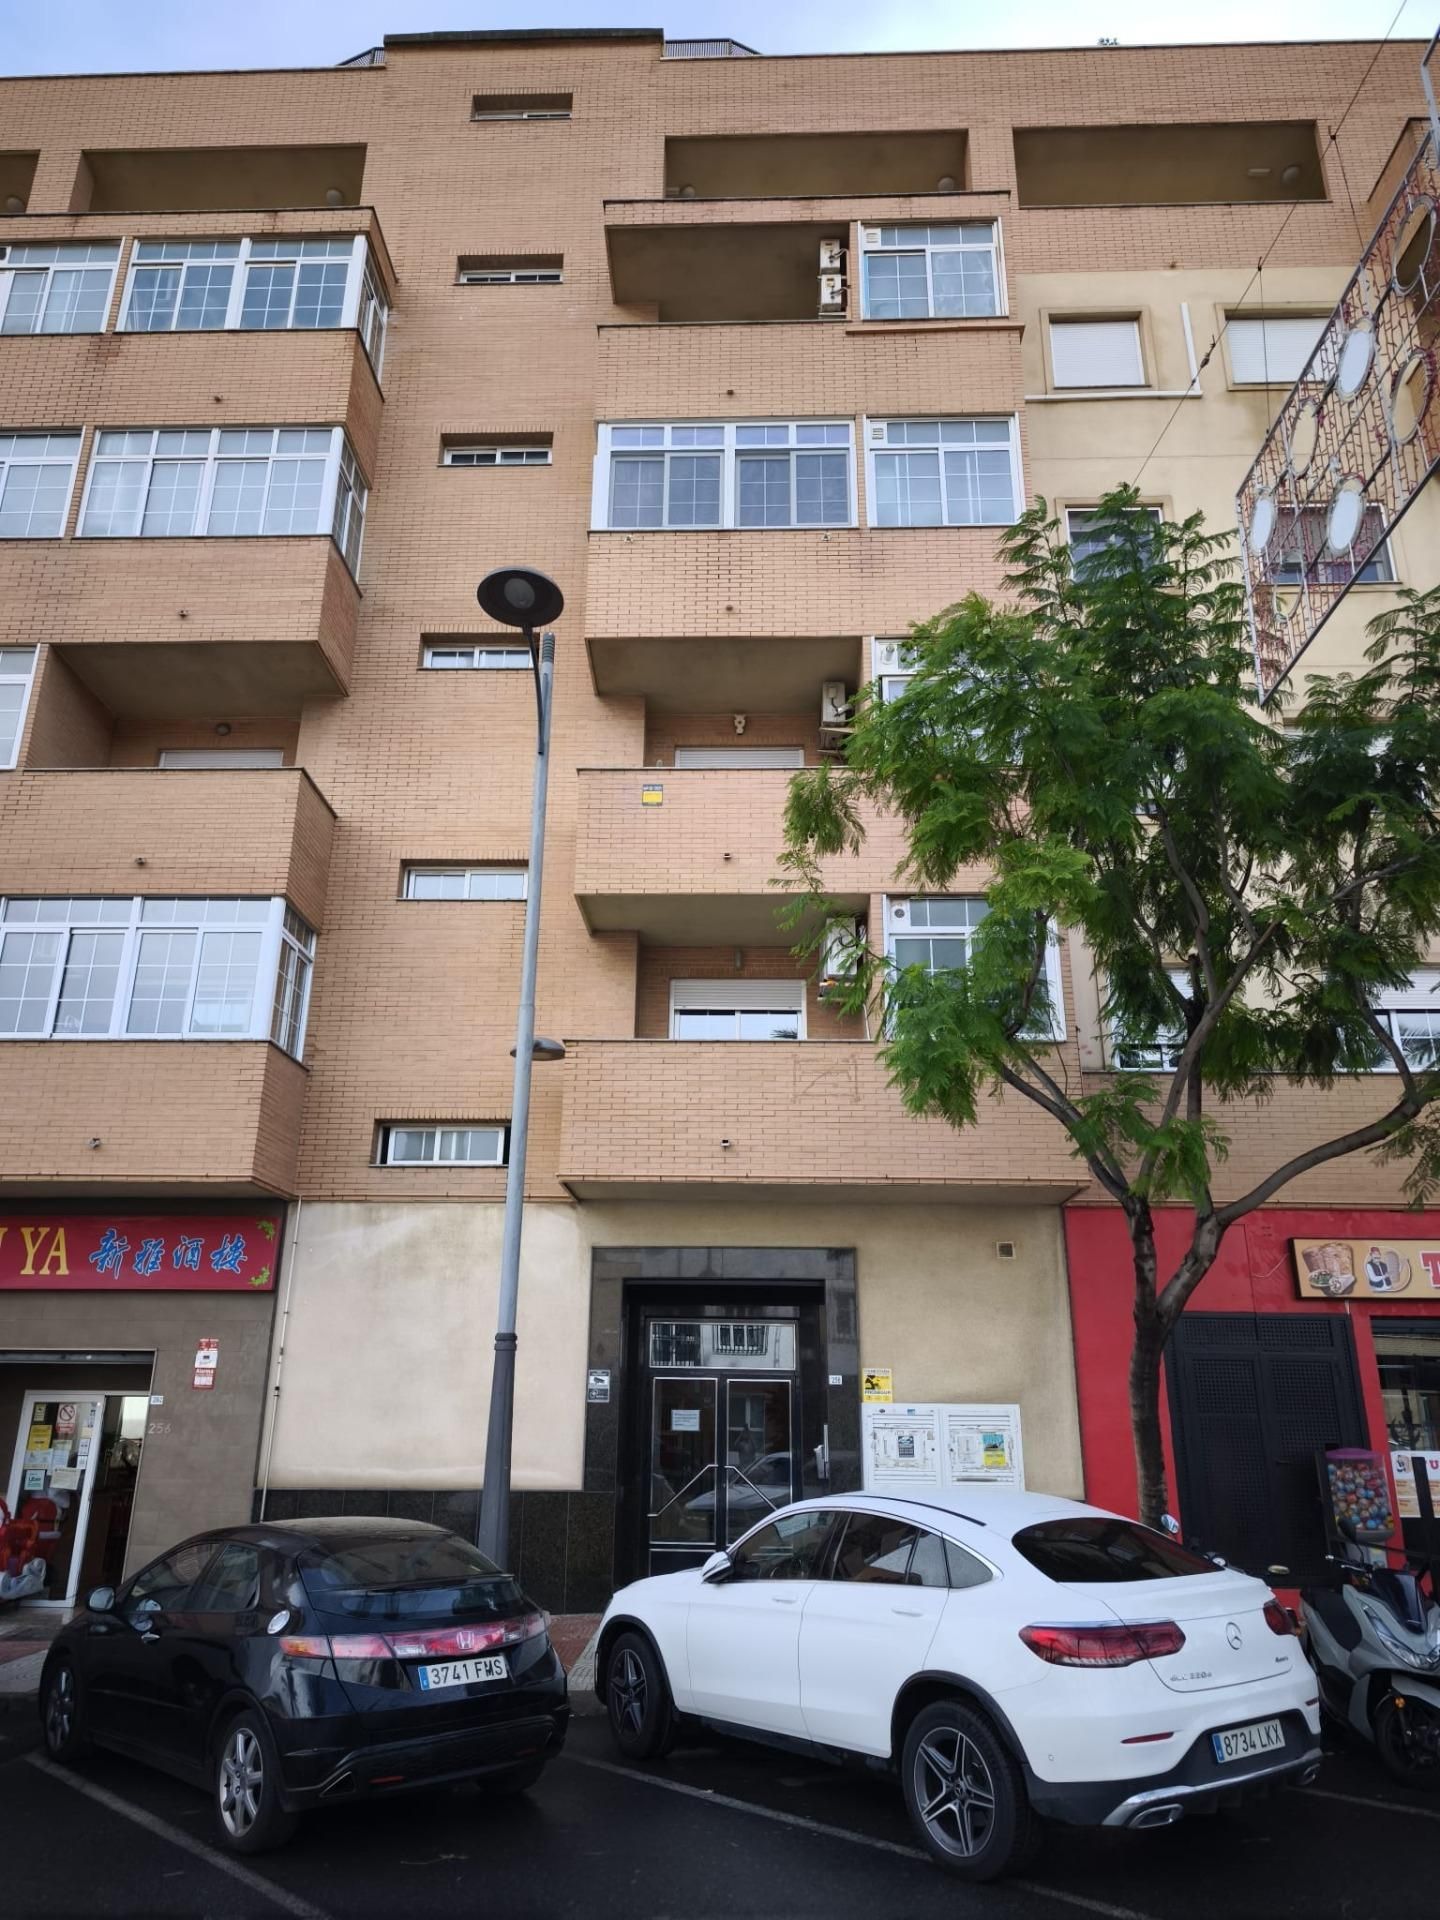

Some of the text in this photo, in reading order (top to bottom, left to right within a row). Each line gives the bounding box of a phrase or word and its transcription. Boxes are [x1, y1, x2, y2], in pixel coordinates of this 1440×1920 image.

[20, 1227, 69, 1275] YA
[431, 1659, 503, 1686] 3741 FMS
[1223, 1723, 1282, 1757] 8734 LKX
